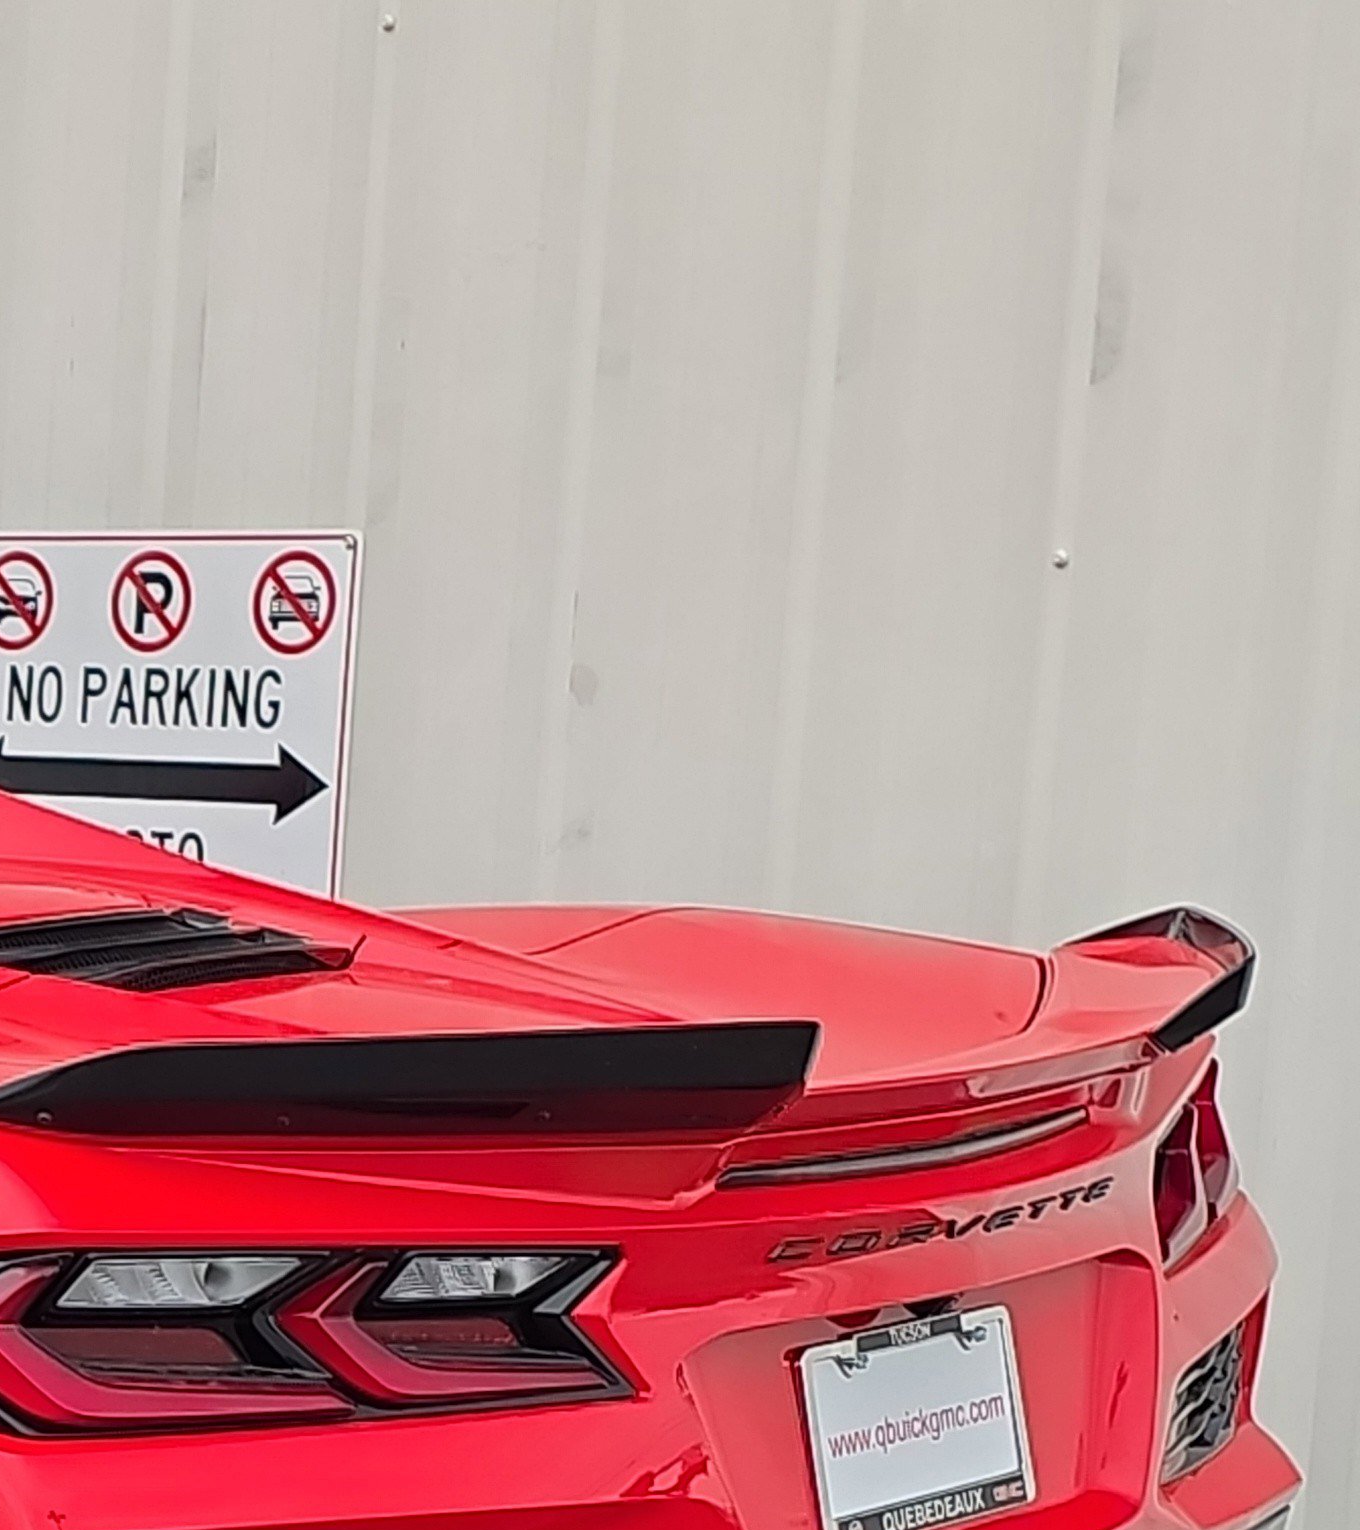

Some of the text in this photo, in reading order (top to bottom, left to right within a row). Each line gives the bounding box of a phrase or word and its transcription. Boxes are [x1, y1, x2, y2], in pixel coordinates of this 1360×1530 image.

[6, 664, 282, 729] NO PARKING
[767, 1176, 1114, 1264] CORVETTE
[828, 1394, 1006, 1459] www.qbuickgmc.com
